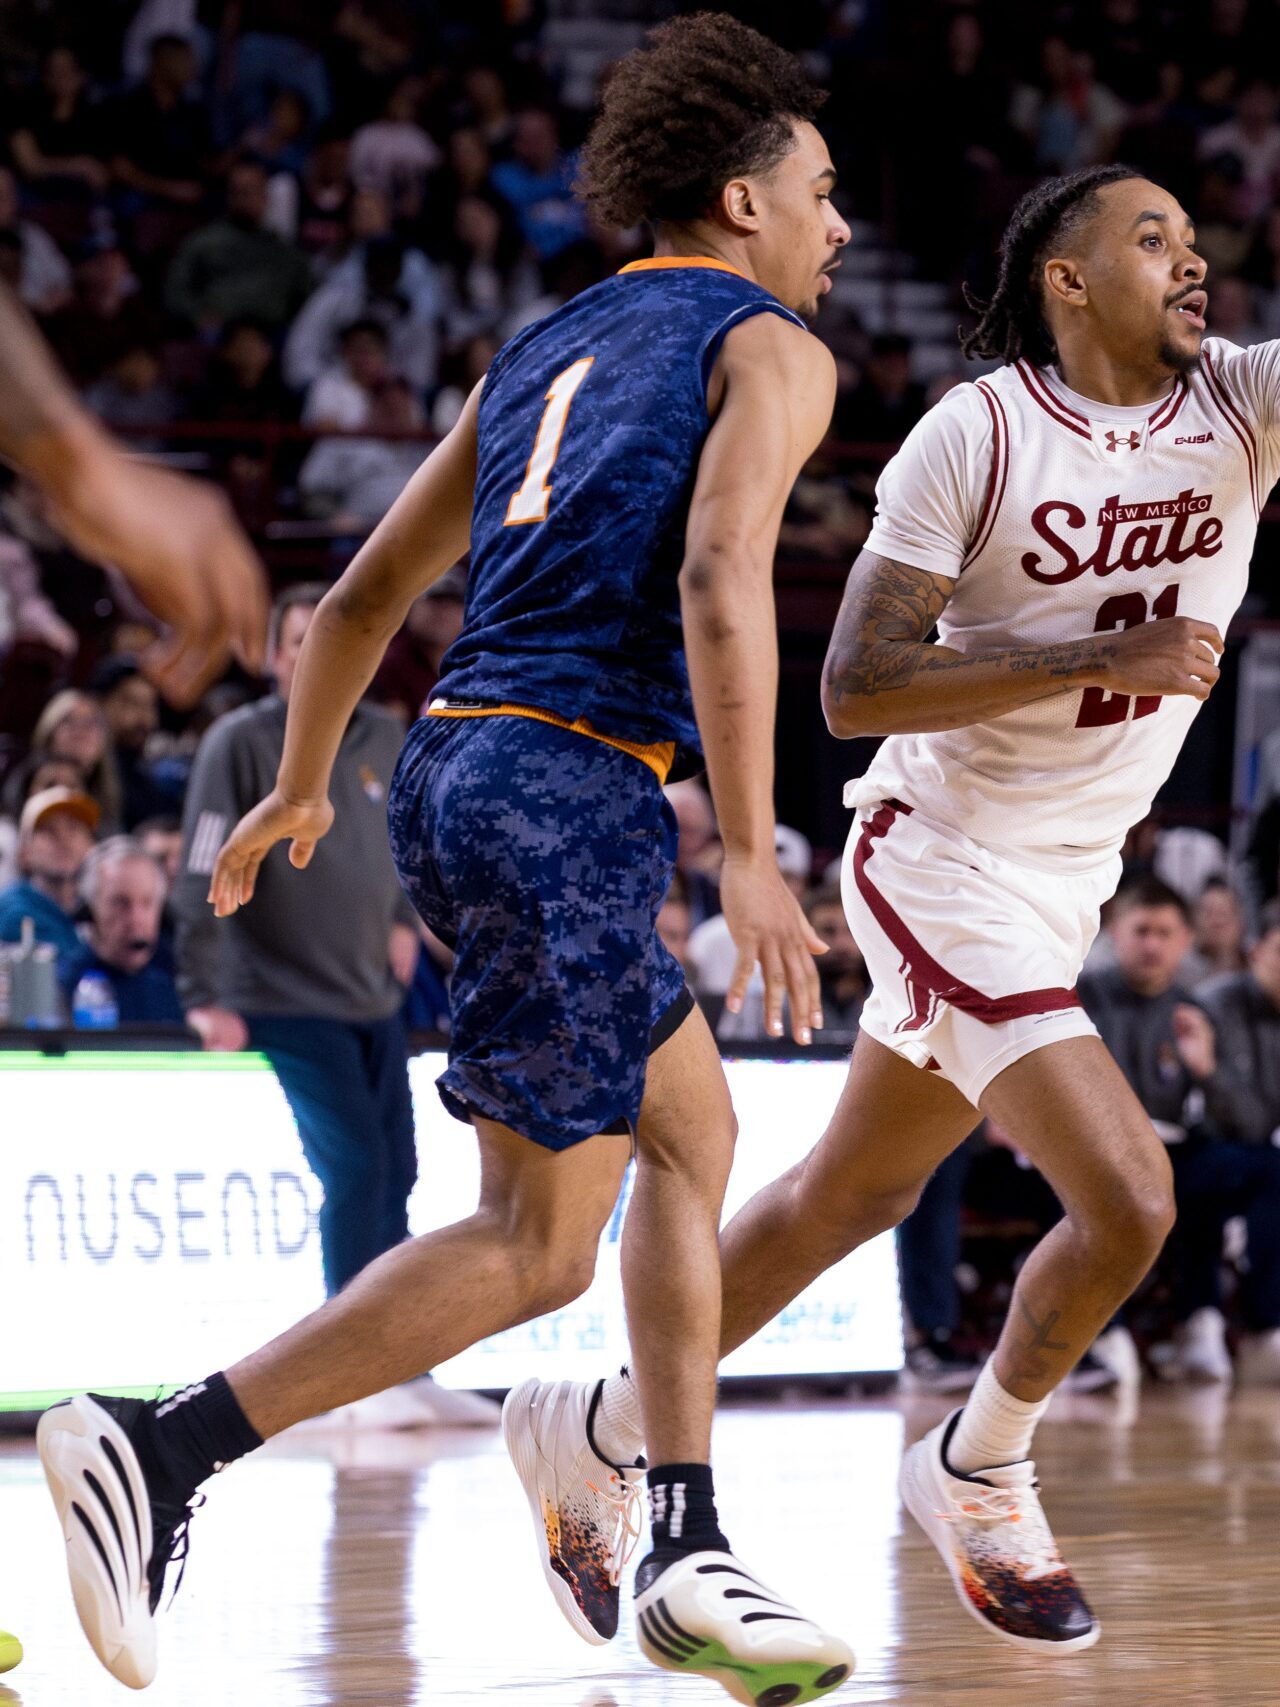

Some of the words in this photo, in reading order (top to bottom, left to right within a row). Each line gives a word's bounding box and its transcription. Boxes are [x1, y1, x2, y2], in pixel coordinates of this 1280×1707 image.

[503, 356, 595, 526] 1
[1174, 431, 1214, 445] C-USA
[1021, 488, 1223, 585] State
[1102, 507, 1138, 522] NEW
[1146, 498, 1208, 517] MEXICO
[24, 1172, 311, 1266] NUSEND
